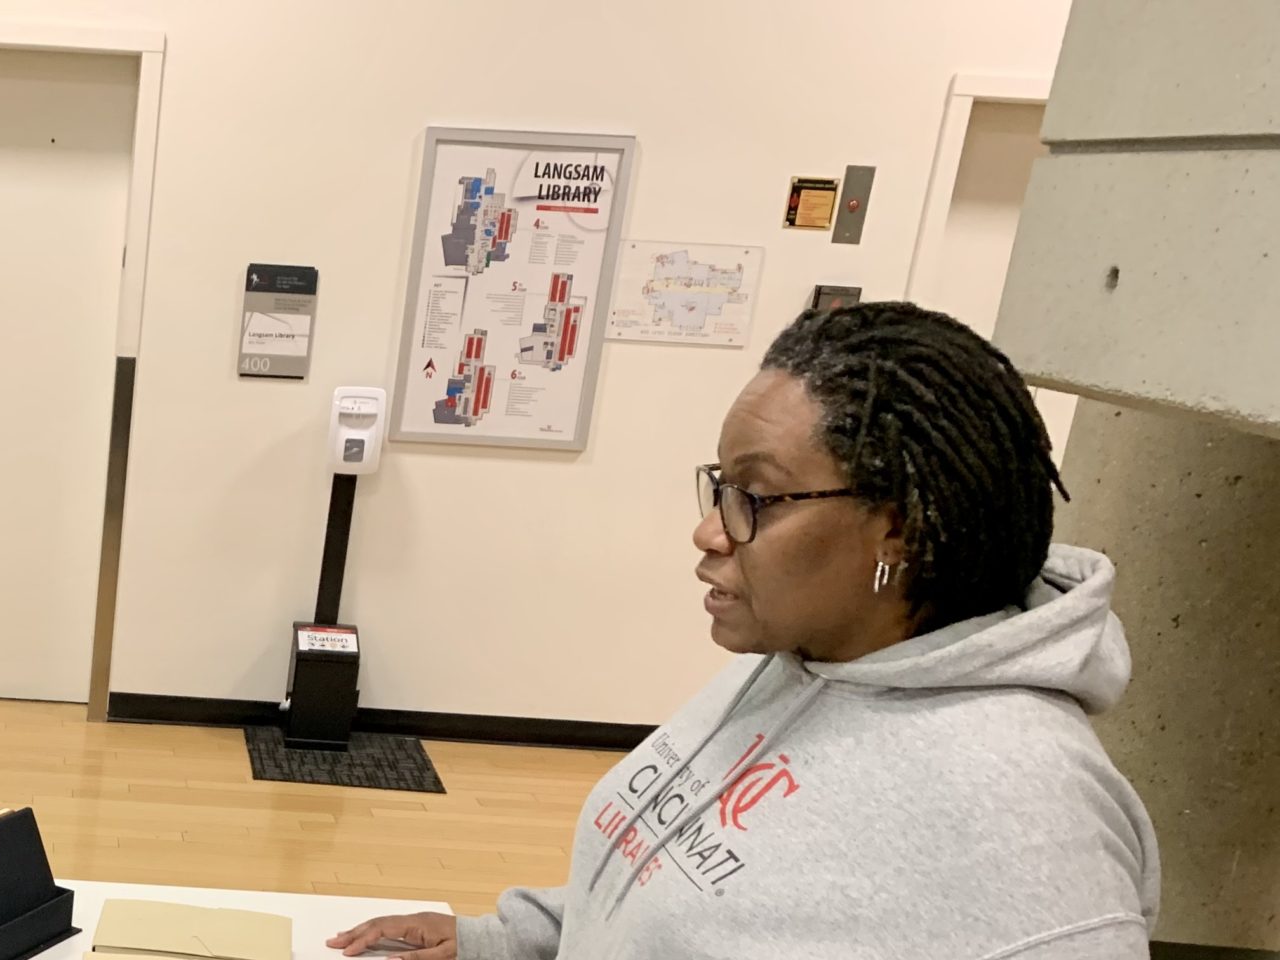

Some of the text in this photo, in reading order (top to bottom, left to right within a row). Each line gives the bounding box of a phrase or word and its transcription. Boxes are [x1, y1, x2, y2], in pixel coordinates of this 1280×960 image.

[534, 162, 605, 182] LANGSAM
[537, 184, 601, 203] LIBRARY
[241, 357, 270, 371] 400
